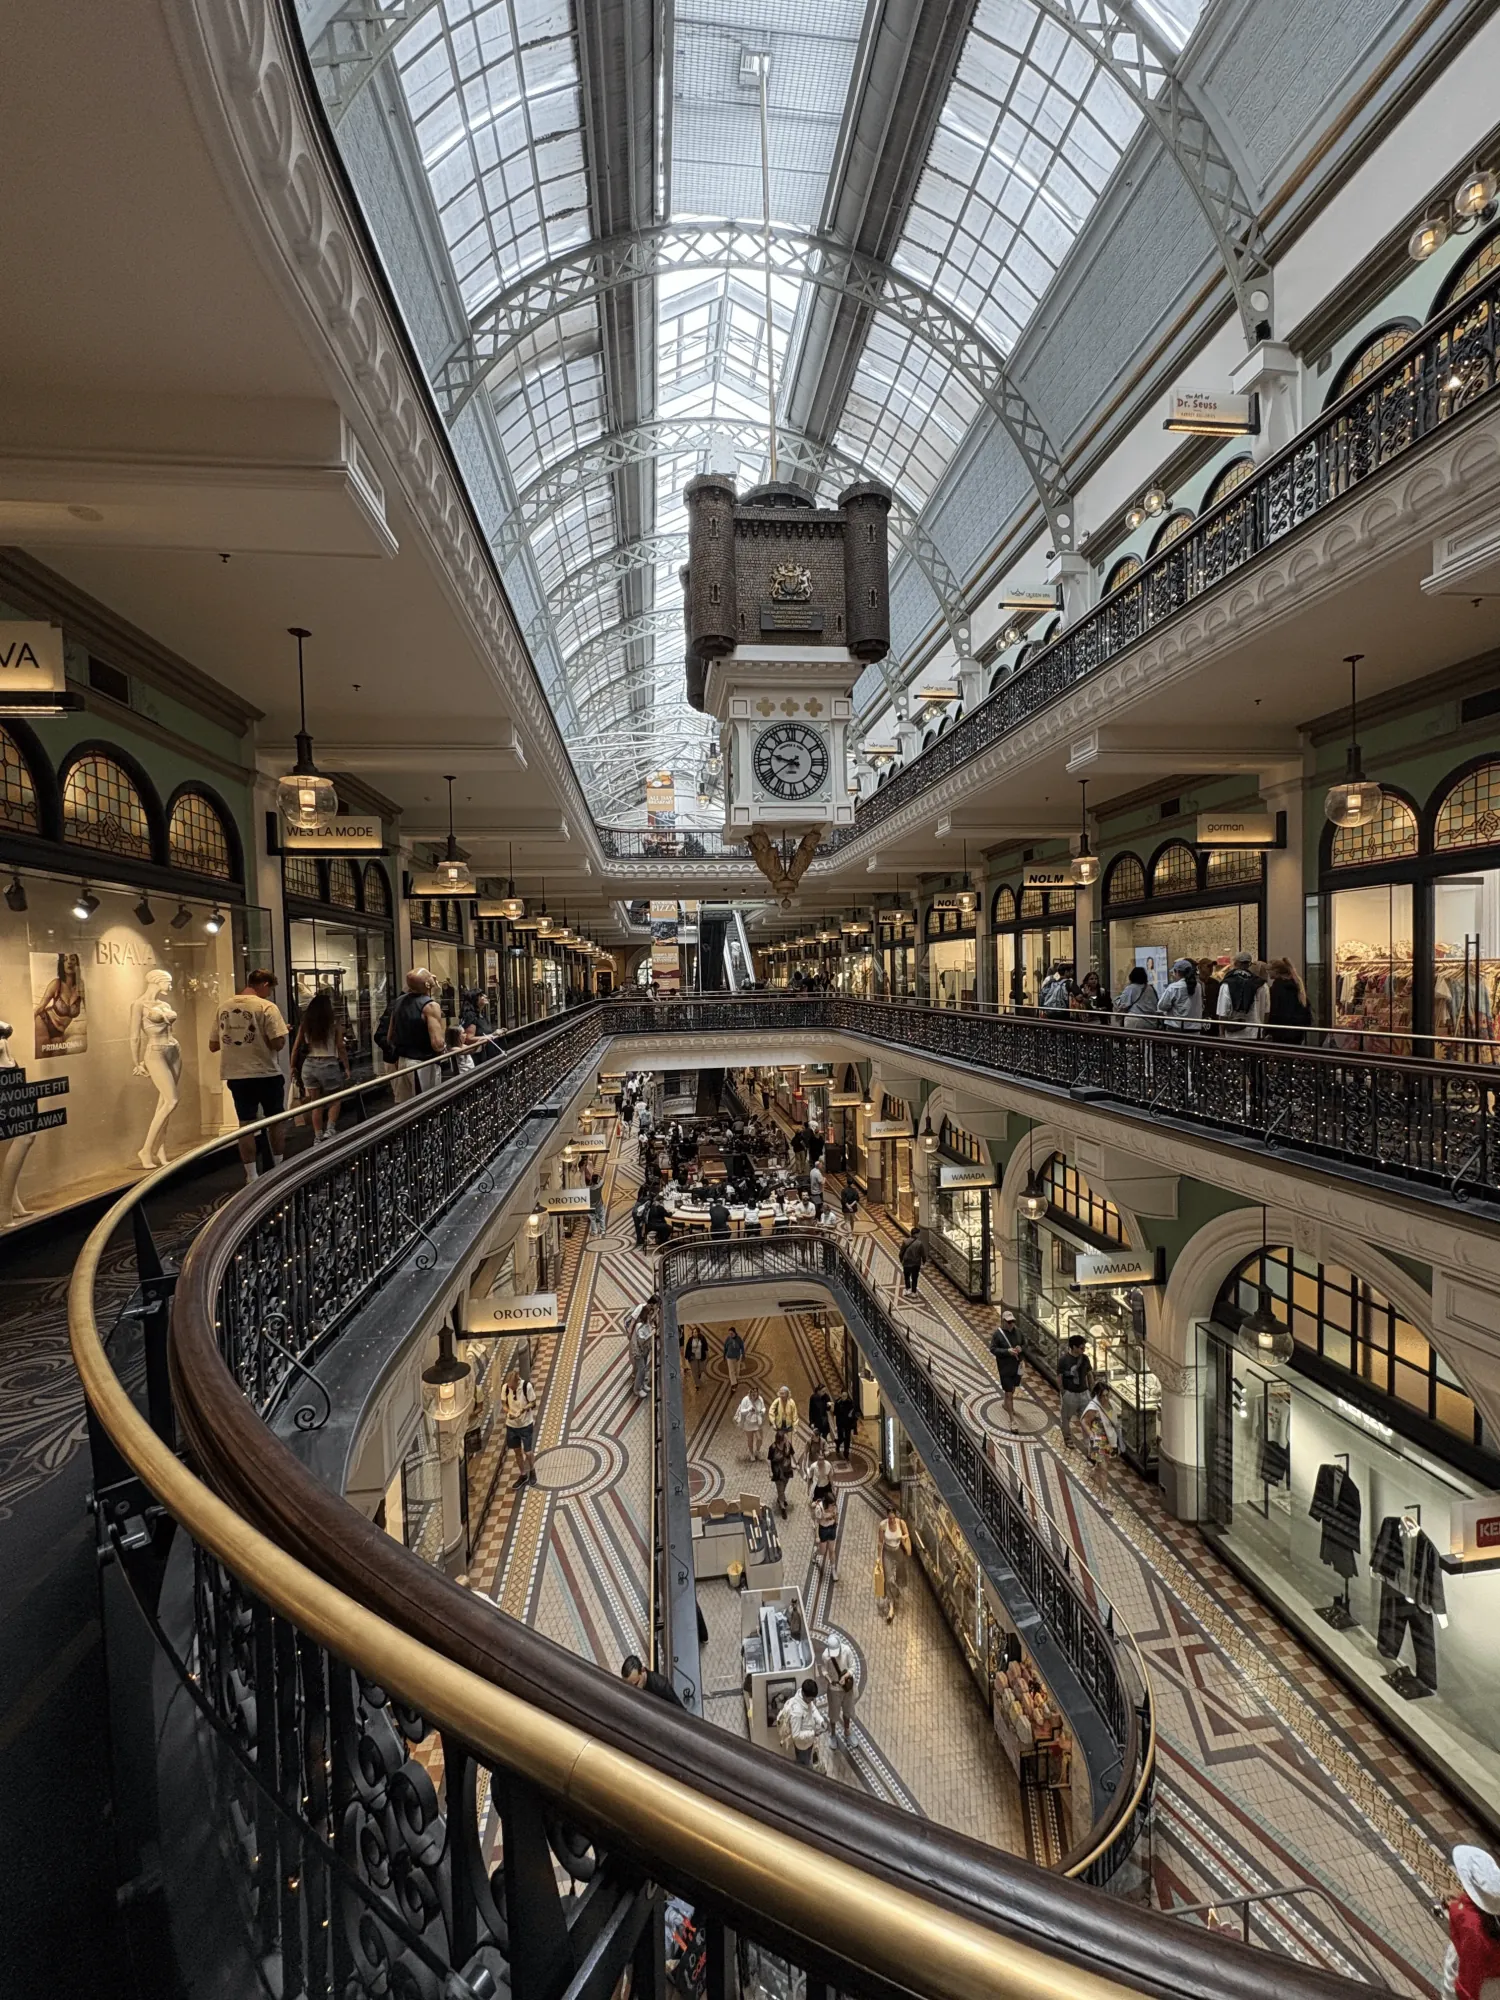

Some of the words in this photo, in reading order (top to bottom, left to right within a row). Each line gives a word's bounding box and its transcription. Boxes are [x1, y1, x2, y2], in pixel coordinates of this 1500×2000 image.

[1176, 398, 1190, 408] Dr.
[1193, 399, 1218, 410] Seuss
[317, 826, 334, 837] LA
[335, 826, 373, 837] MODE
[1207, 824, 1245, 833] gorman
[1028, 874, 1064, 884] NOLM
[937, 899, 957, 907] NOL
[95, 940, 157, 966] BRAVA
[52, 1080, 67, 1093] FIT
[8, 1102, 36, 1118] ONLY
[7, 1119, 34, 1136] VISIT
[36, 1112, 65, 1129] AWAY
[951, 1172, 986, 1181] WAMADA
[548, 1195, 587, 1205] OROTON
[1092, 1262, 1142, 1275] WAMADA
[493, 1306, 553, 1320] OROTON
[1480, 1521, 1500, 1538] KE
